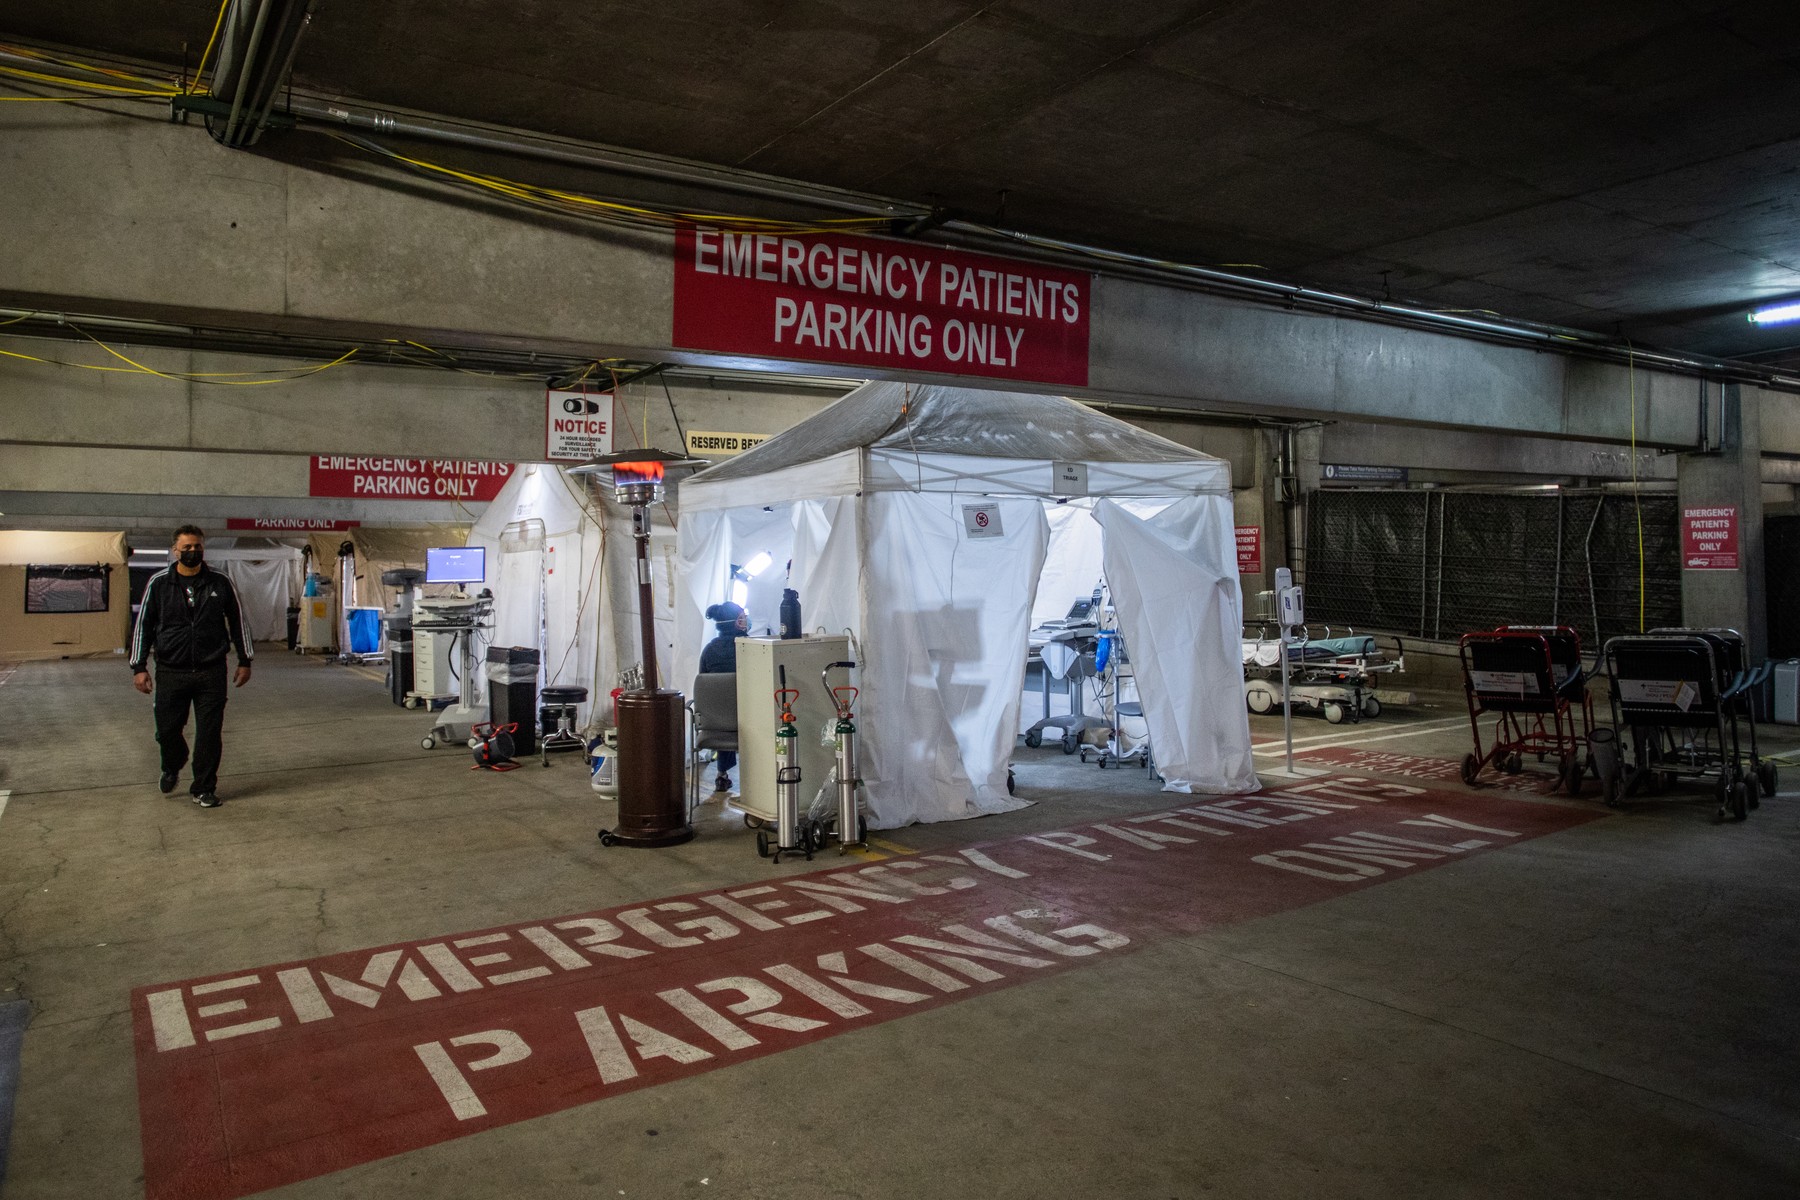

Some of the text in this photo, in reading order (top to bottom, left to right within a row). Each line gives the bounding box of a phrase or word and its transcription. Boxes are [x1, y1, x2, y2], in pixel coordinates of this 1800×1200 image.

[695, 225, 1080, 324] EMERGENCY PATIENTS
[774, 297, 1025, 368] PARKING ONLY
[554, 418, 607, 435] NOTICE
[691, 436, 763, 450] RESERVED BEY
[318, 456, 427, 473] EMERGENCY
[354, 475, 478, 496] PARKING ONLY
[1684, 508, 1735, 517] EMERGENCY
[255, 518, 336, 529] PARKING ONLY
[1691, 520, 1729, 528] PATIENTS
[1692, 531, 1728, 540] PARKING
[1699, 543, 1721, 551] ONLY
[146, 777, 1428, 1053] EMERGENCY PATIENTS
[413, 813, 1523, 1121] PARKING ONLY
